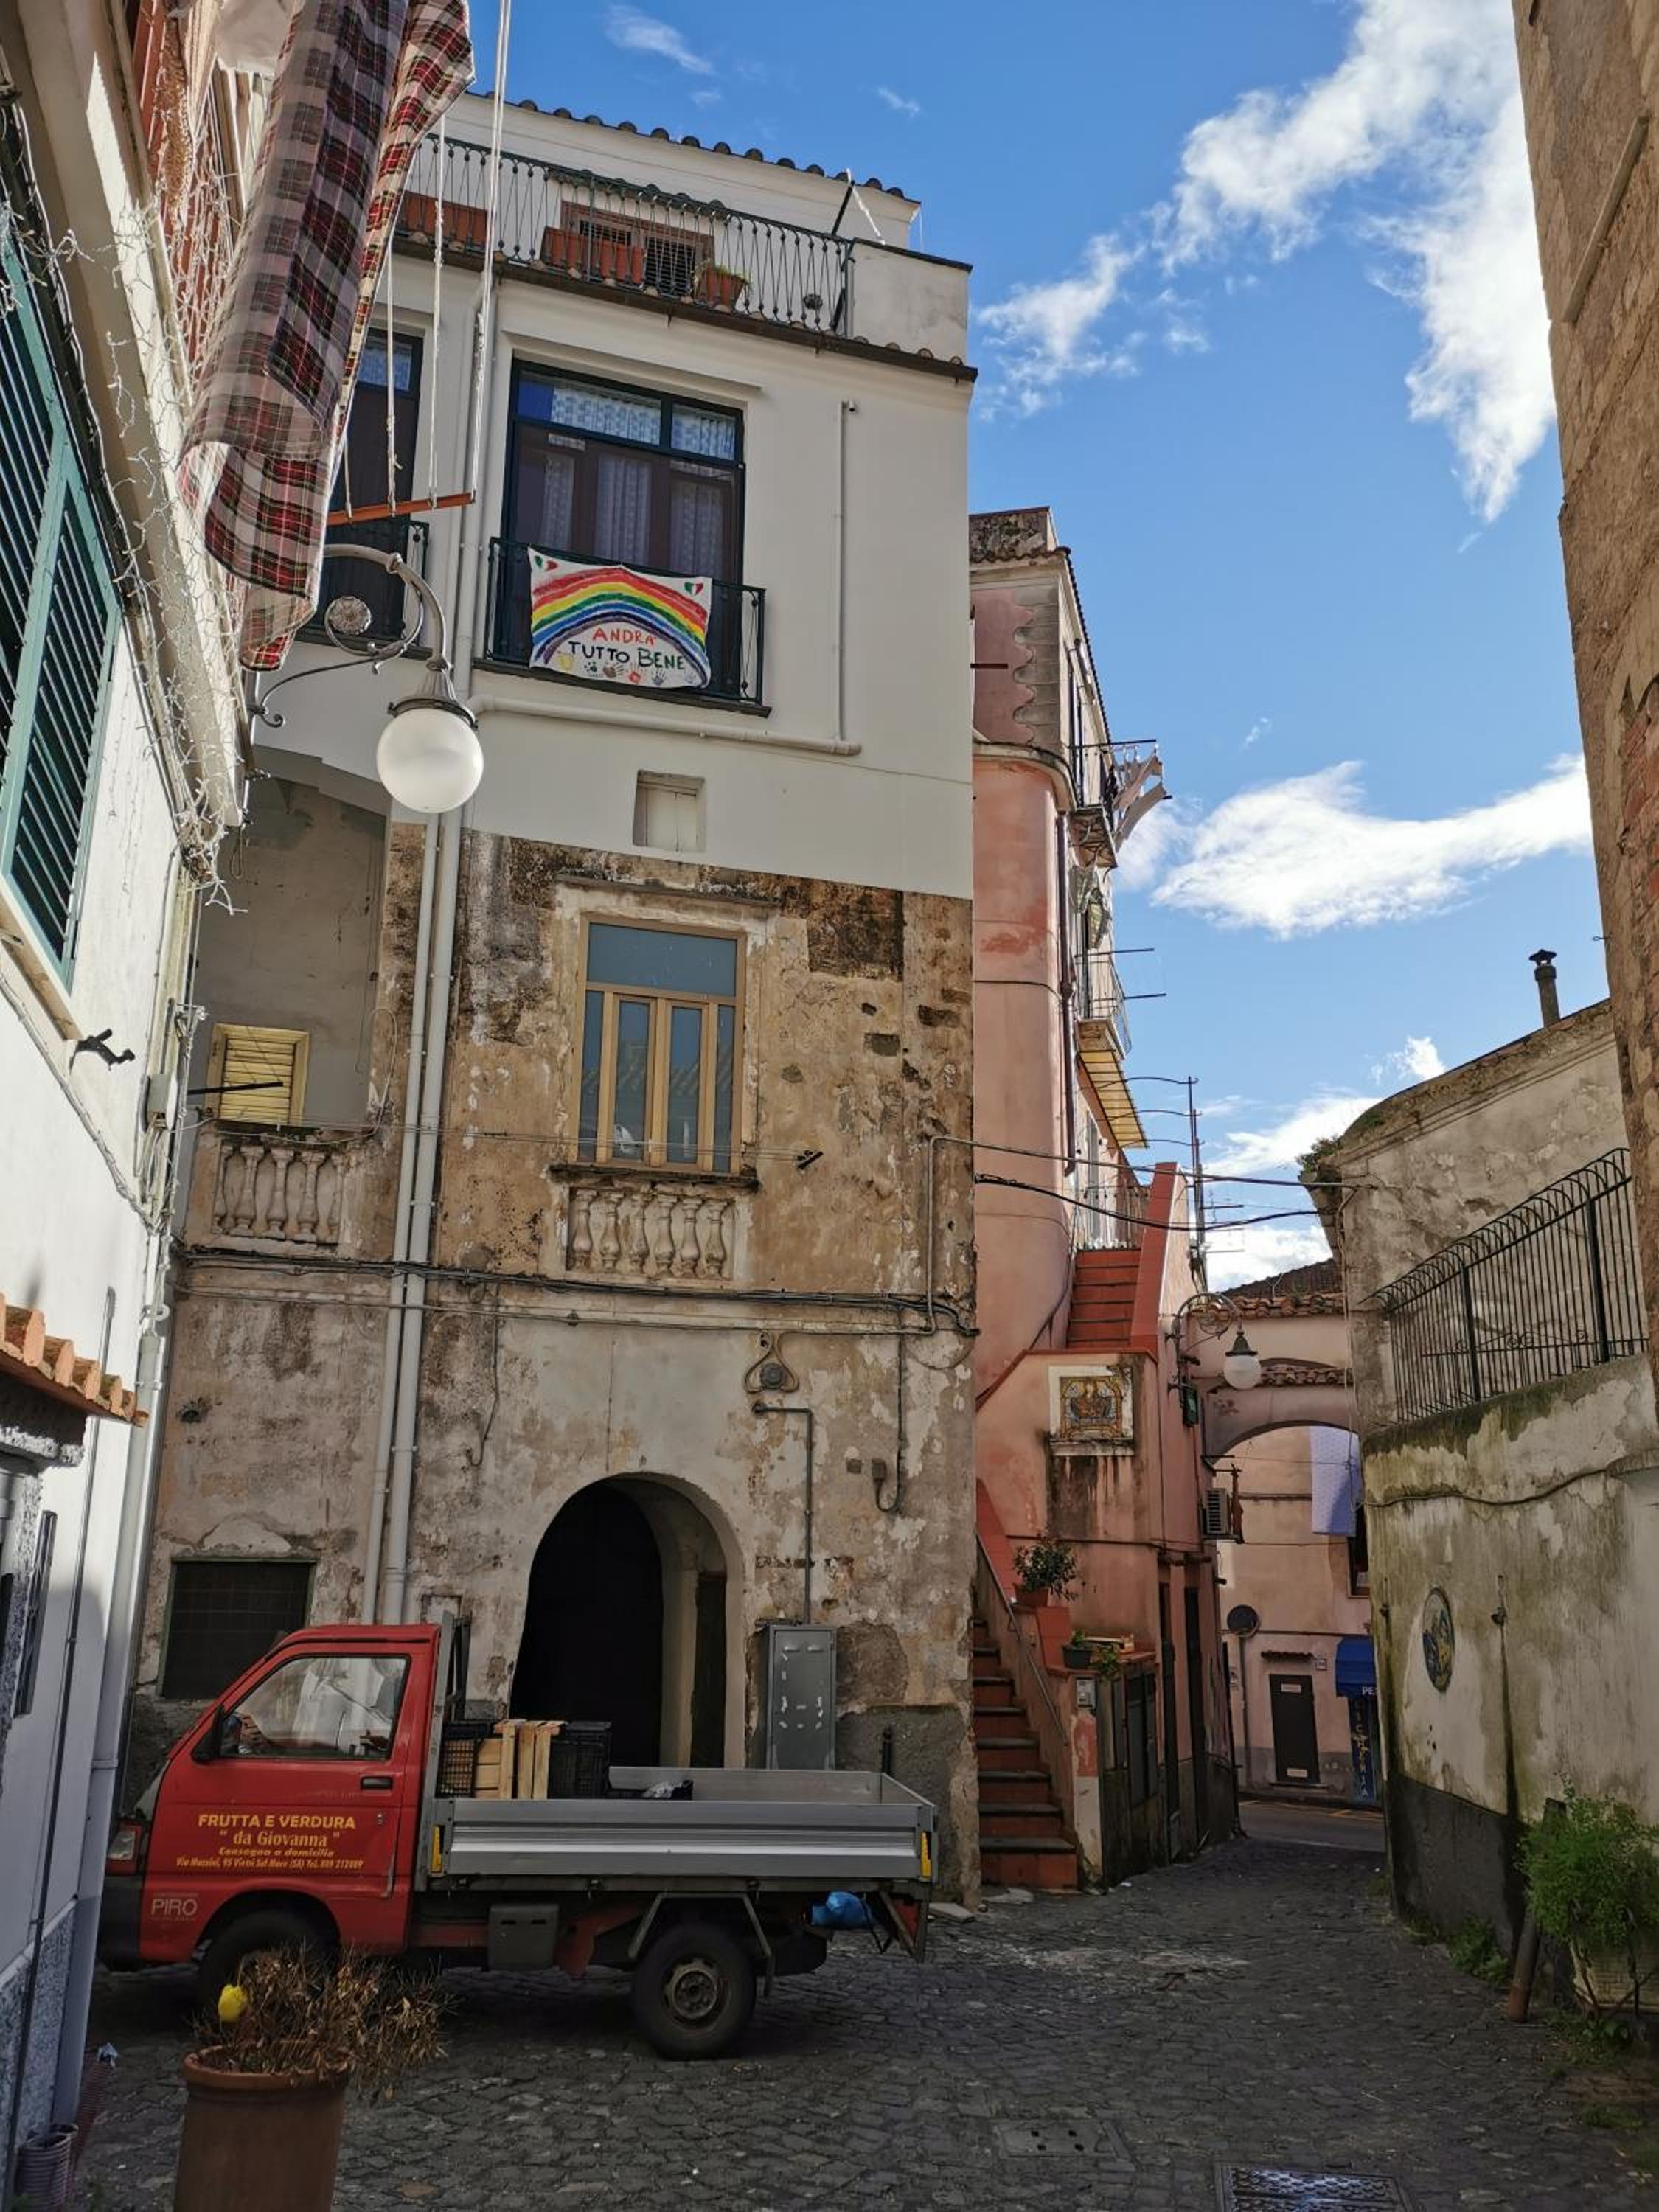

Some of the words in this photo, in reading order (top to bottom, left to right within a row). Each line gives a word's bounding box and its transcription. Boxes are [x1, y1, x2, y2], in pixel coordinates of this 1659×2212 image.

[568, 641, 630, 664] TUTTO
[637, 647, 686, 670] BENE
[198, 1814, 260, 1828] FRUTTA
[265, 1815, 275, 1828] E
[279, 1815, 355, 1829] VERDURA
[233, 1830, 251, 1846] da
[257, 1831, 327, 1847] Giovanna
[285, 1848, 335, 1857] domicilio
